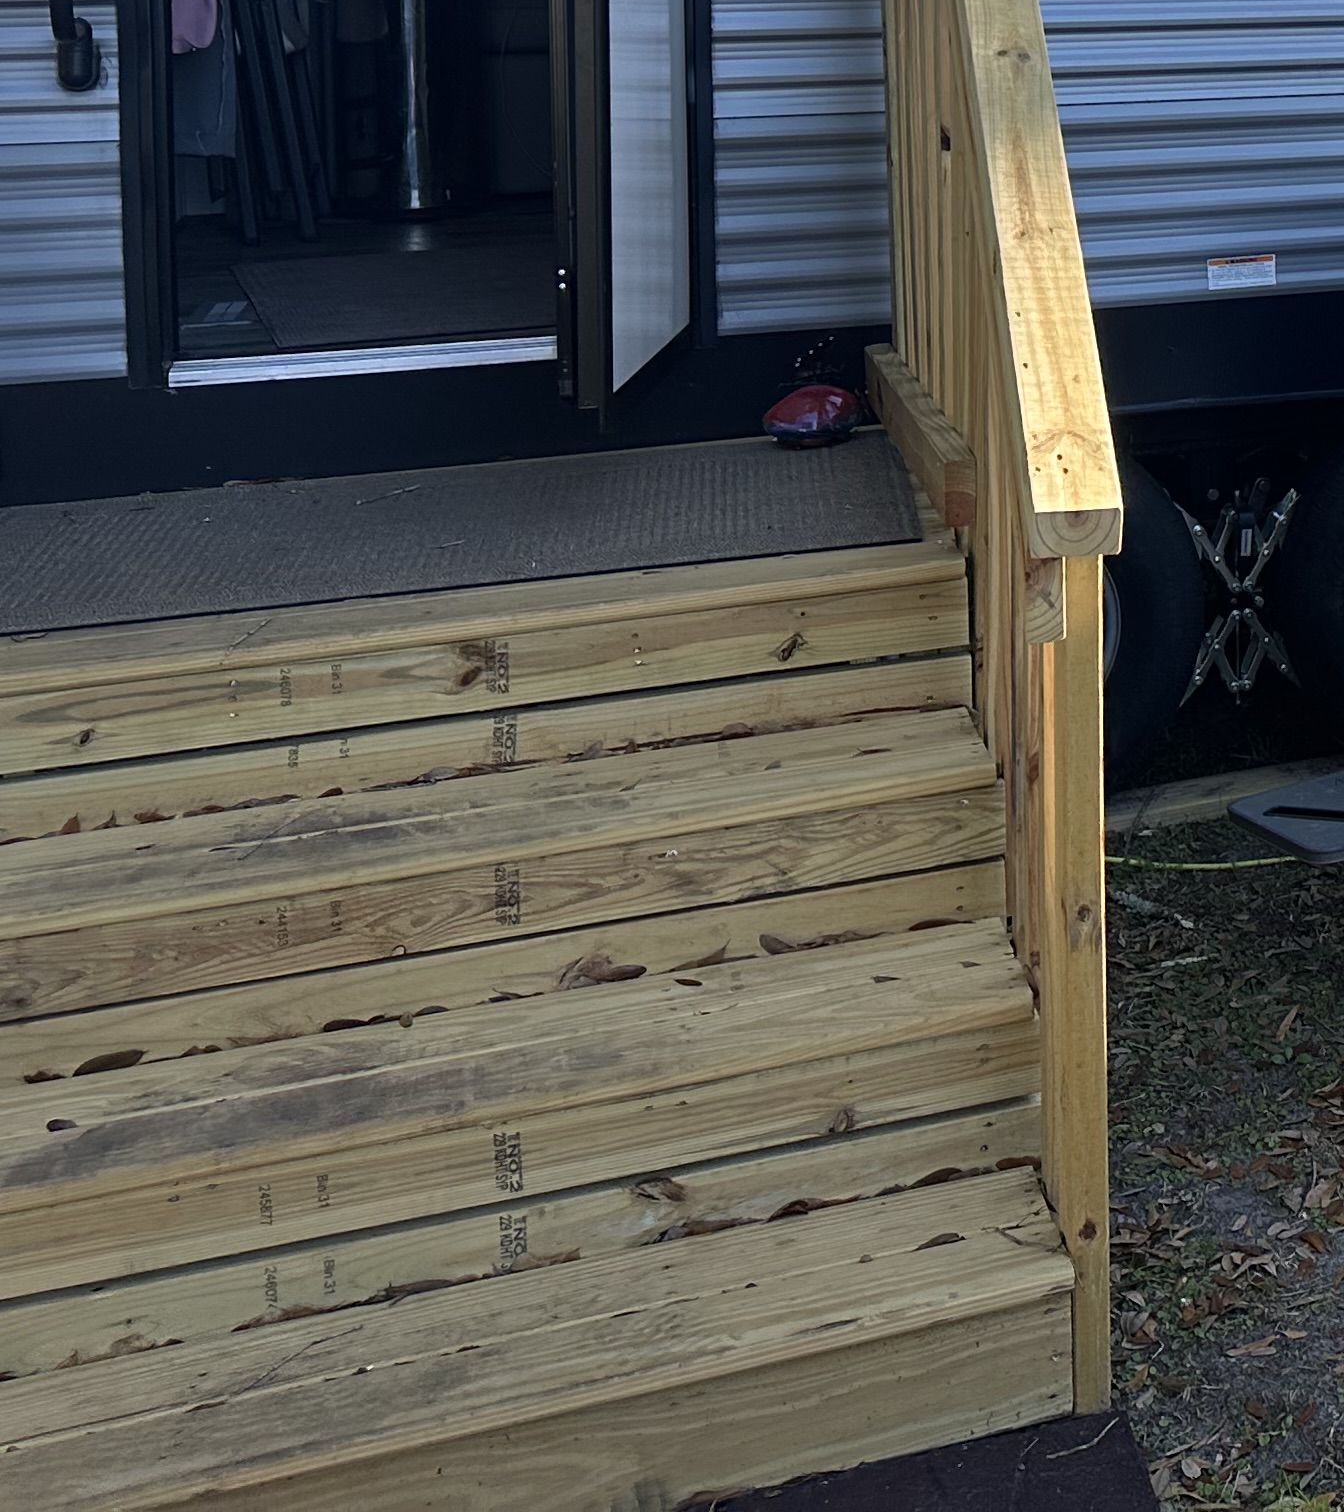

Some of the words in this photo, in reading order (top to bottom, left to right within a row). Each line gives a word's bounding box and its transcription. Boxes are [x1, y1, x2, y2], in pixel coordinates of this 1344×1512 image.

[331, 682, 342, 695] 31
[276, 905, 289, 947] 244153
[331, 921, 343, 933] 31
[317, 1174, 329, 1193] Bin
[495, 1174, 508, 1191] SYP
[258, 1184, 273, 1226] 245877
[318, 1195, 330, 1208] 31
[499, 1214, 513, 1231] 229
[499, 1232, 513, 1260] KDHT
[324, 1259, 336, 1279] Bin
[324, 1281, 336, 1296] 31
